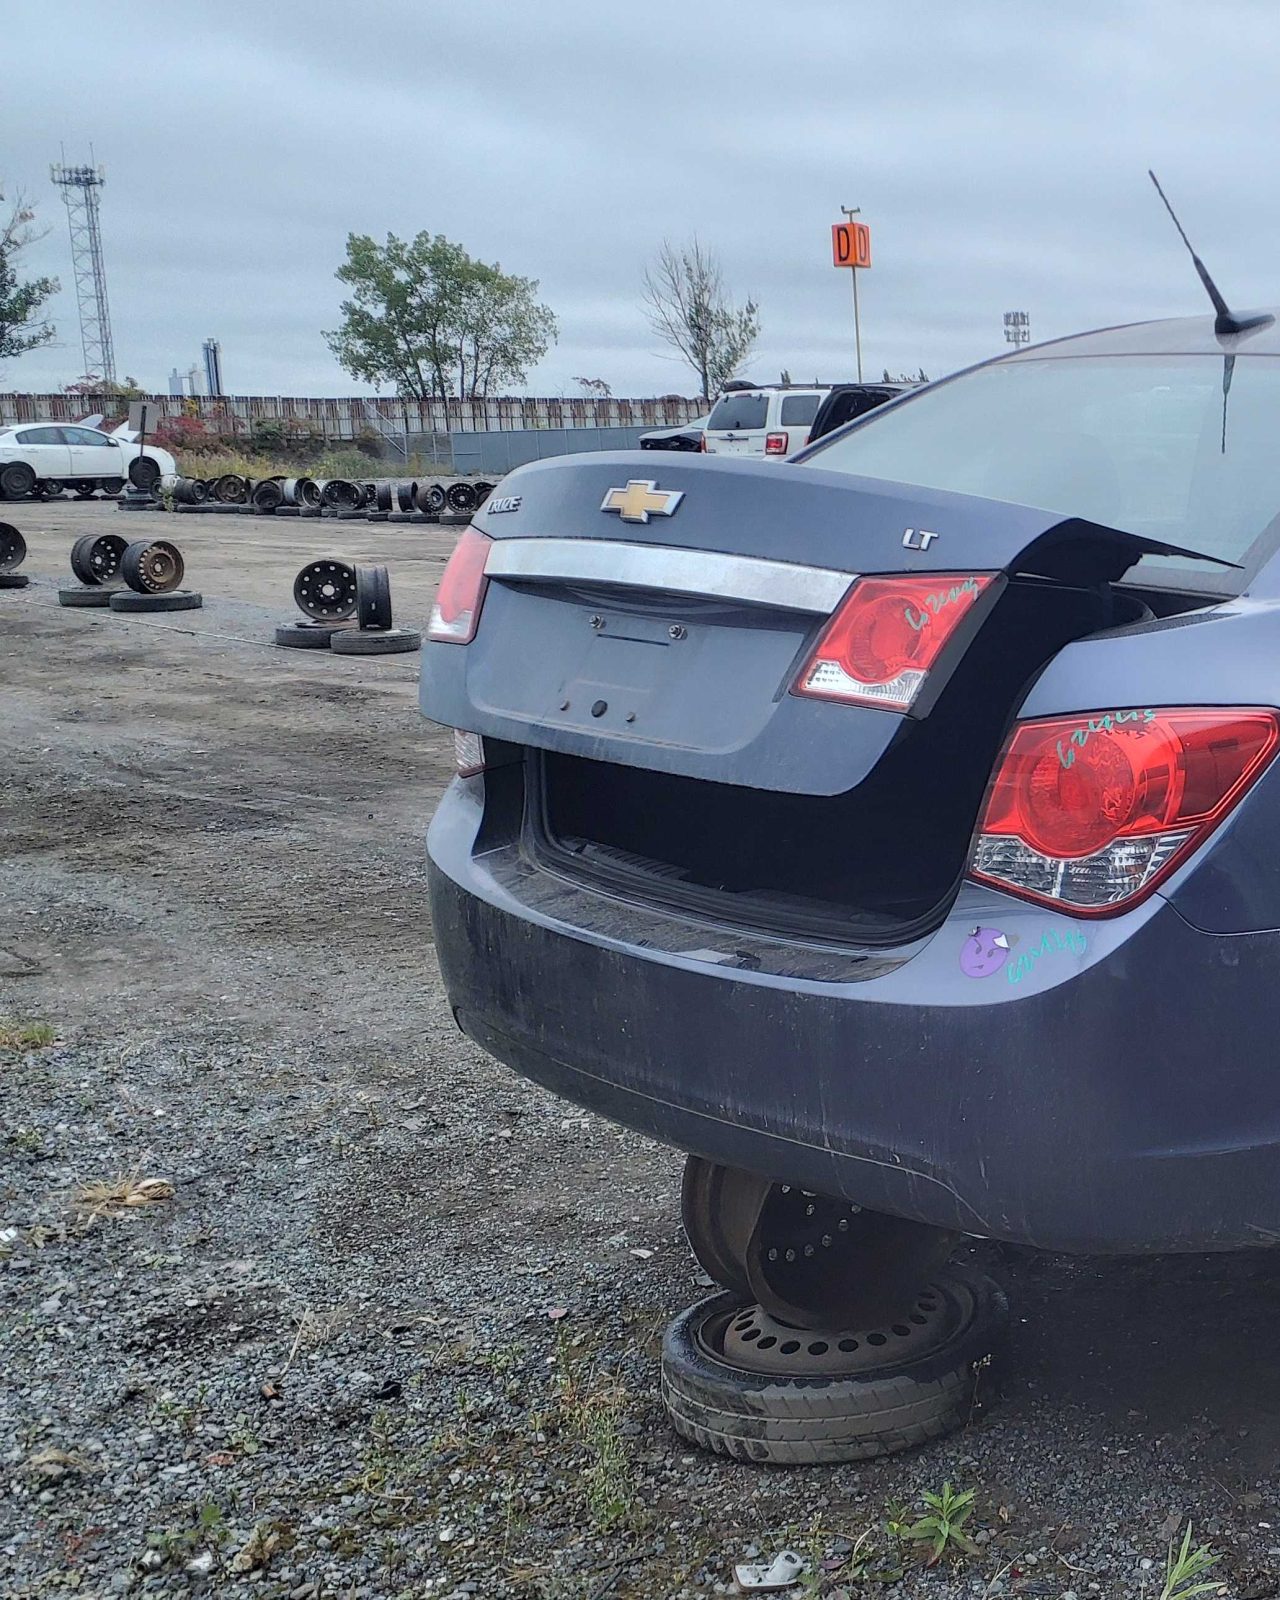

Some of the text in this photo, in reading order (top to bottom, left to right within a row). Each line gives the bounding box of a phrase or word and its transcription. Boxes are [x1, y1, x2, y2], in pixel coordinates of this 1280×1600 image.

[837, 227, 850, 262] D
[487, 495, 523, 515] CRUZE
[902, 528, 940, 551] LT
